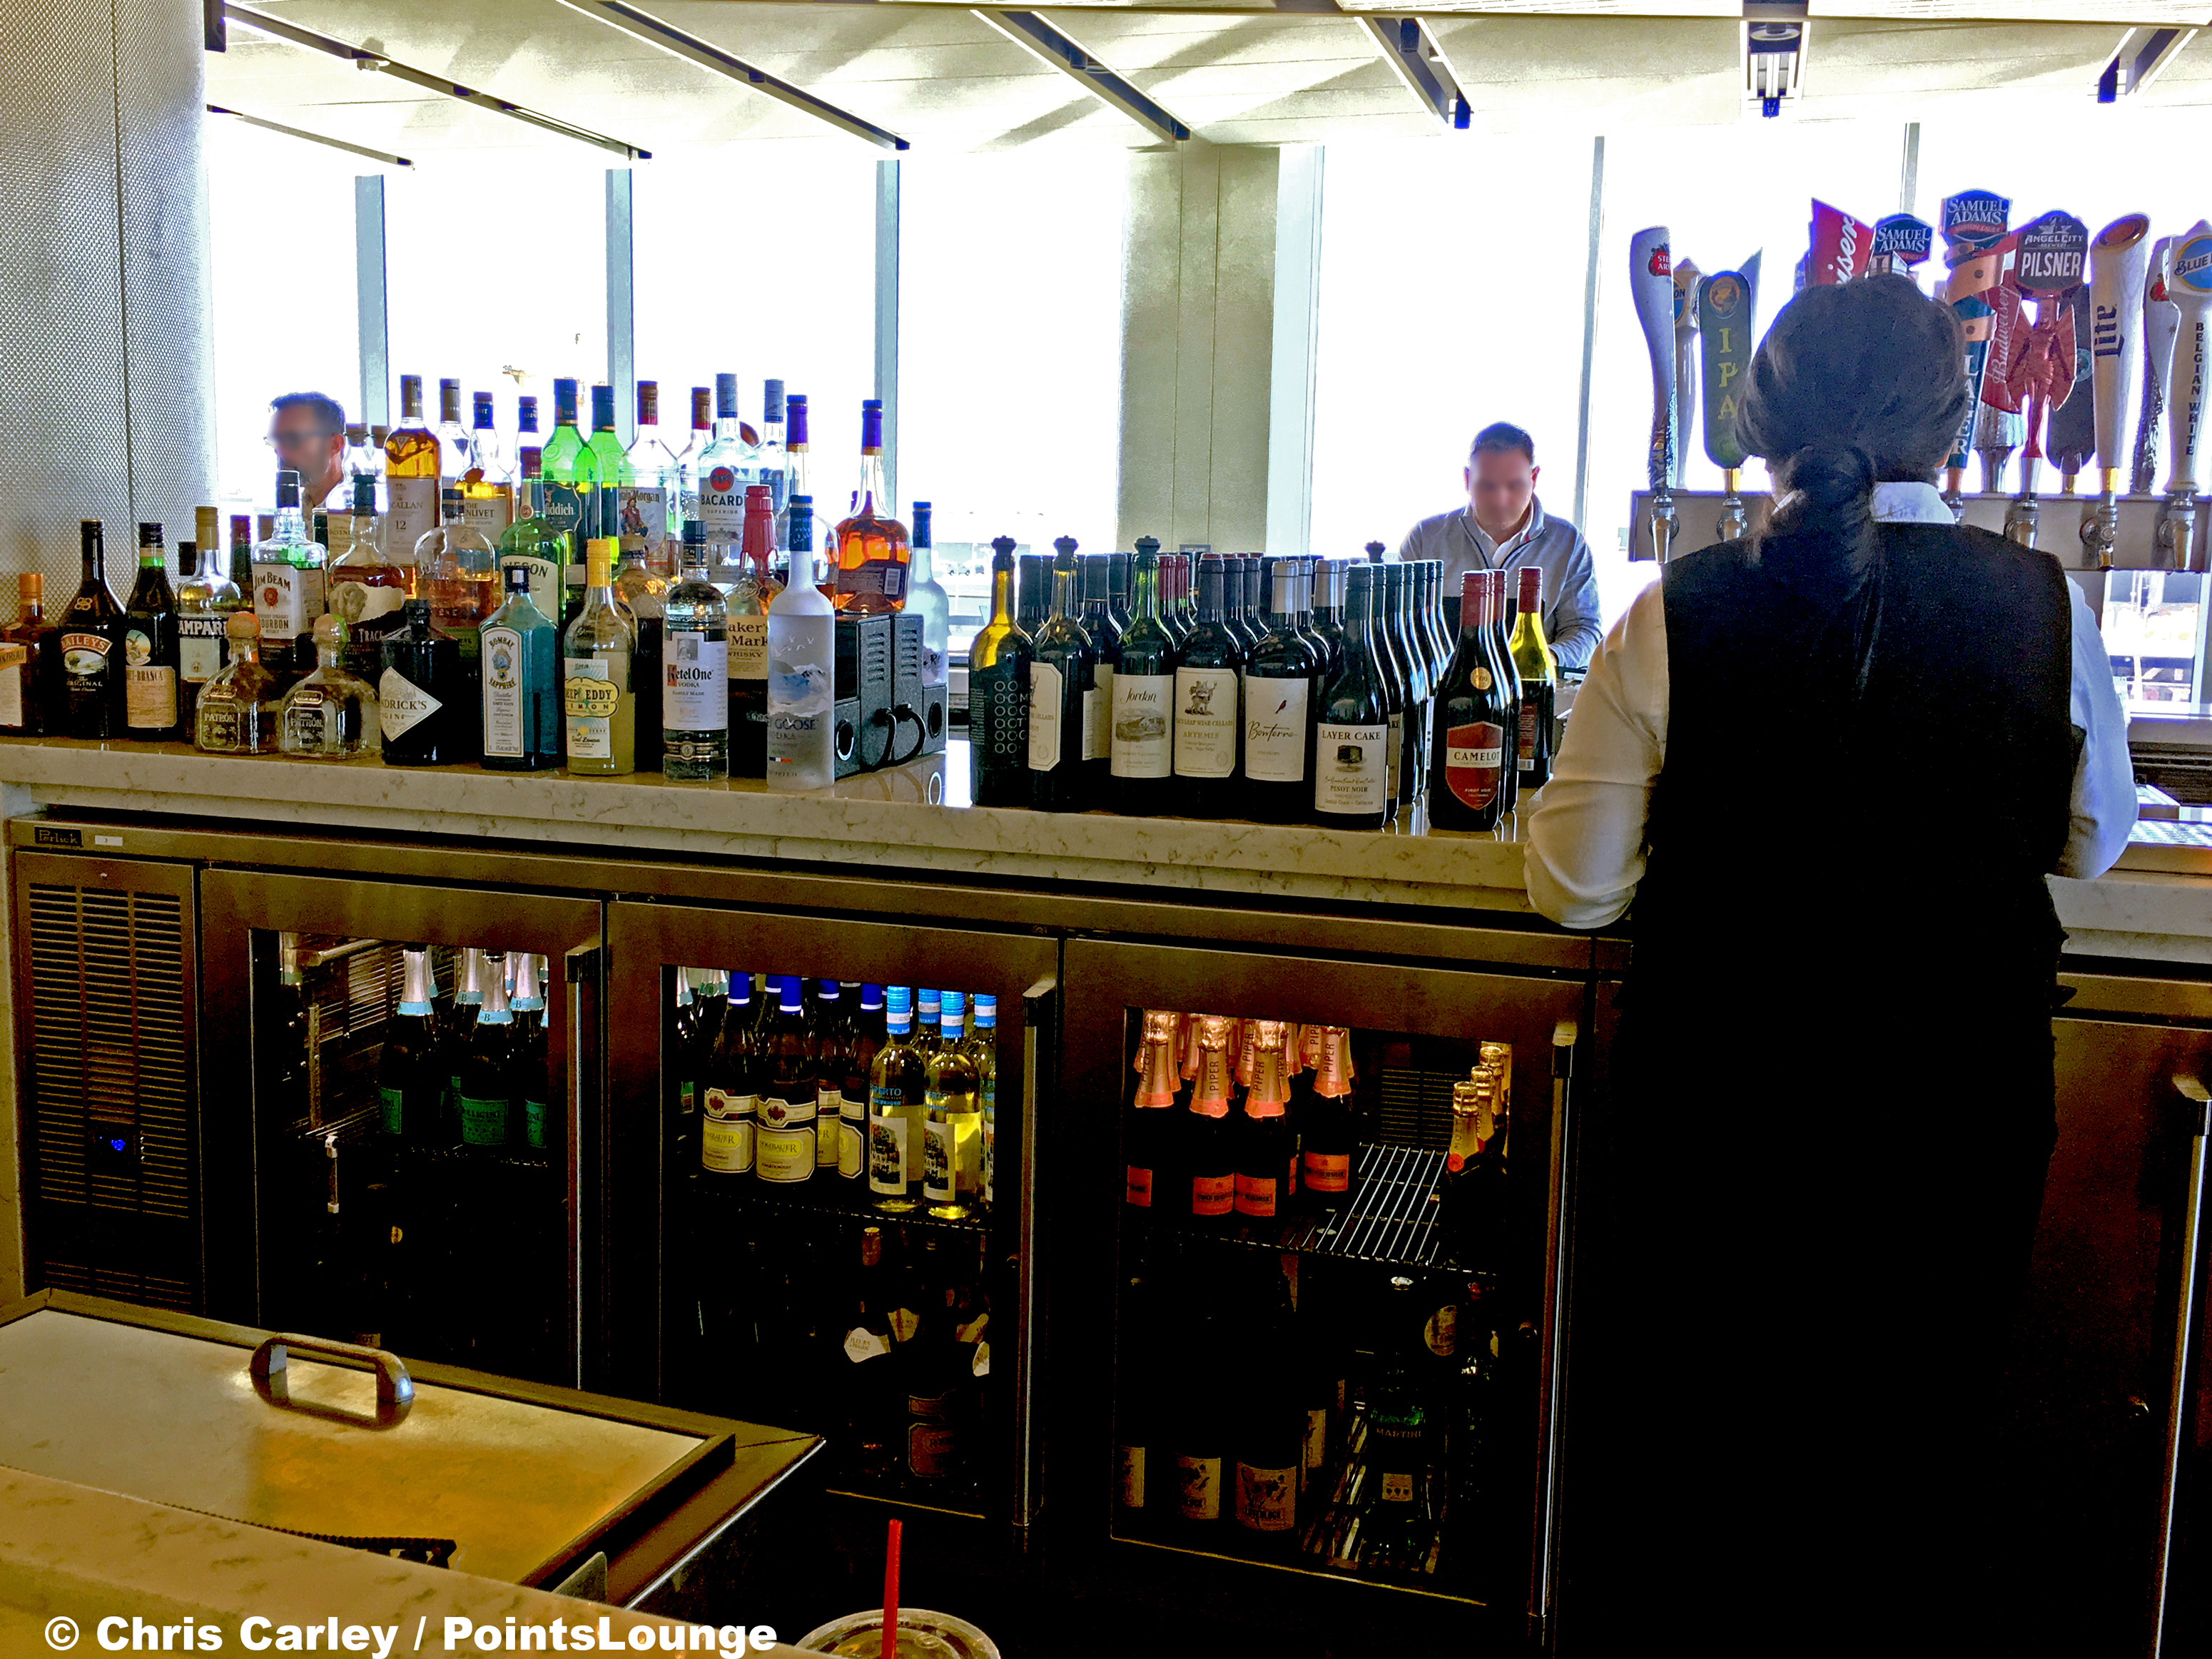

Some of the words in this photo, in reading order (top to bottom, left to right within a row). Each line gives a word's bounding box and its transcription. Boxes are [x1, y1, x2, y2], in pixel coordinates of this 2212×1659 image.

[1948, 198, 2008, 213] SAMUEL
[1950, 212, 2002, 225] ADAMS
[1876, 227, 1931, 242] SAMUEL
[2024, 235, 2063, 245] ANGEL
[2064, 235, 2084, 243] CITY
[1879, 240, 1925, 253] ADAMS
[2020, 252, 2081, 278] PILSNER
[2173, 255, 2208, 276] BLUE
[1986, 286, 2009, 384] Budweiser
[2190, 322, 2204, 396] BELGIAN
[1718, 328, 1739, 420] IPA
[2185, 402, 2201, 456] WHITE
[631, 489, 660, 504] Morgan
[701, 494, 744, 506] BACARD
[390, 501, 422, 509] CALLAN
[545, 503, 574, 515] fiddich
[465, 509, 494, 518] NLIVET
[395, 519, 407, 530] 12
[254, 575, 266, 591] JIM
[267, 572, 291, 592] BEAM
[260, 618, 289, 629] OURBON
[489, 636, 515, 650] BOMBAY
[693, 667, 712, 681] One
[488, 676, 517, 690] SAPPHIRE
[585, 689, 612, 700] EDDY
[1120, 687, 1157, 704] Jordan
[1182, 731, 1219, 739] ARTEMIS
[1247, 721, 1298, 742] Bonterra
[1321, 730, 1351, 740] LAYER
[1354, 731, 1381, 741] CAKE
[1453, 751, 1500, 761] CAMELOT
[39, 829, 78, 844] Perlick
[1323, 1043, 1334, 1073] PIPER
[1209, 1060, 1219, 1092] PIPER
[1252, 1060, 1265, 1092] PIPER
[1376, 1428, 1421, 1438] MARTINI
